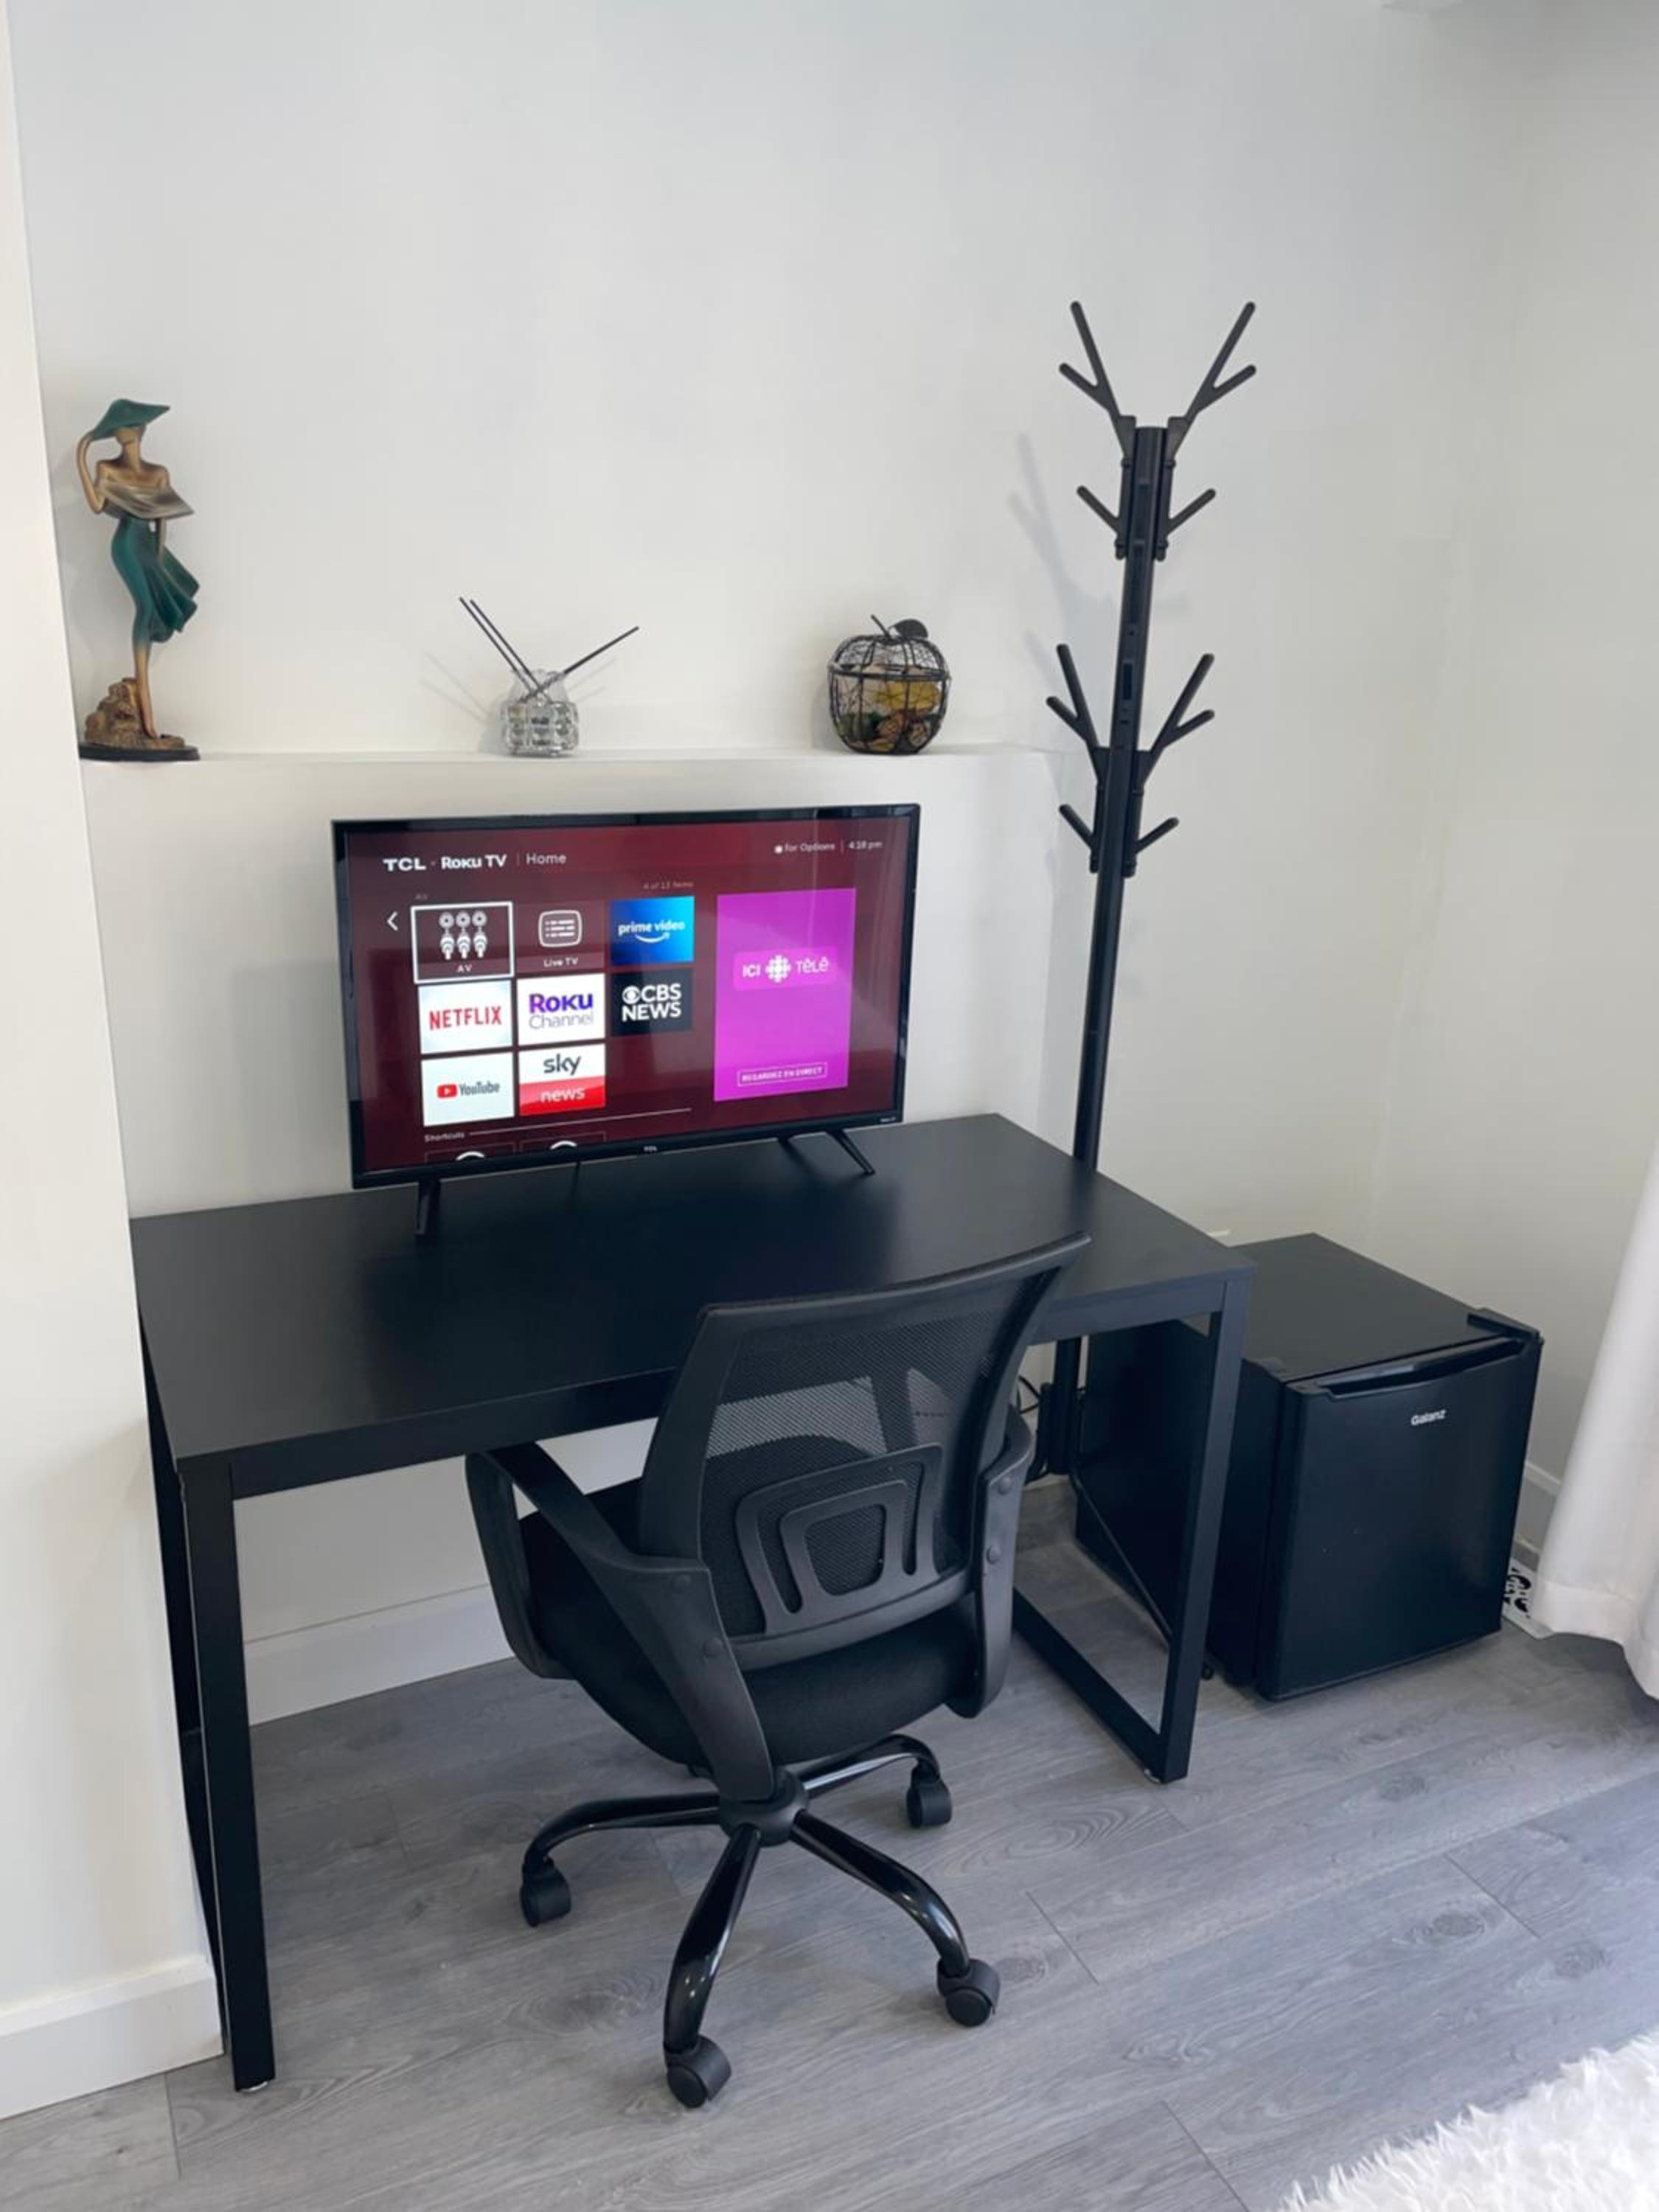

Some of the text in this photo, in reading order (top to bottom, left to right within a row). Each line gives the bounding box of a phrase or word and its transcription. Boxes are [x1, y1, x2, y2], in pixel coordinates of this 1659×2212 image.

[800, 843, 835, 852] Options
[383, 858, 426, 872] TCL
[485, 854, 507, 868] TV
[526, 852, 567, 865] Home
[618, 919, 685, 936] prime video
[457, 964, 473, 973] AV
[543, 957, 578, 968] Live TV
[742, 964, 761, 978] ICI
[641, 983, 682, 1001] CBS
[429, 1005, 503, 1031] NETFLIX
[529, 1010, 594, 1030] Channel
[622, 1001, 682, 1023] NEWS
[543, 1054, 582, 1076] sky
[459, 1080, 501, 1096] YouTube
[540, 1087, 585, 1103] news
[424, 1132, 465, 1142] Shortcuts
